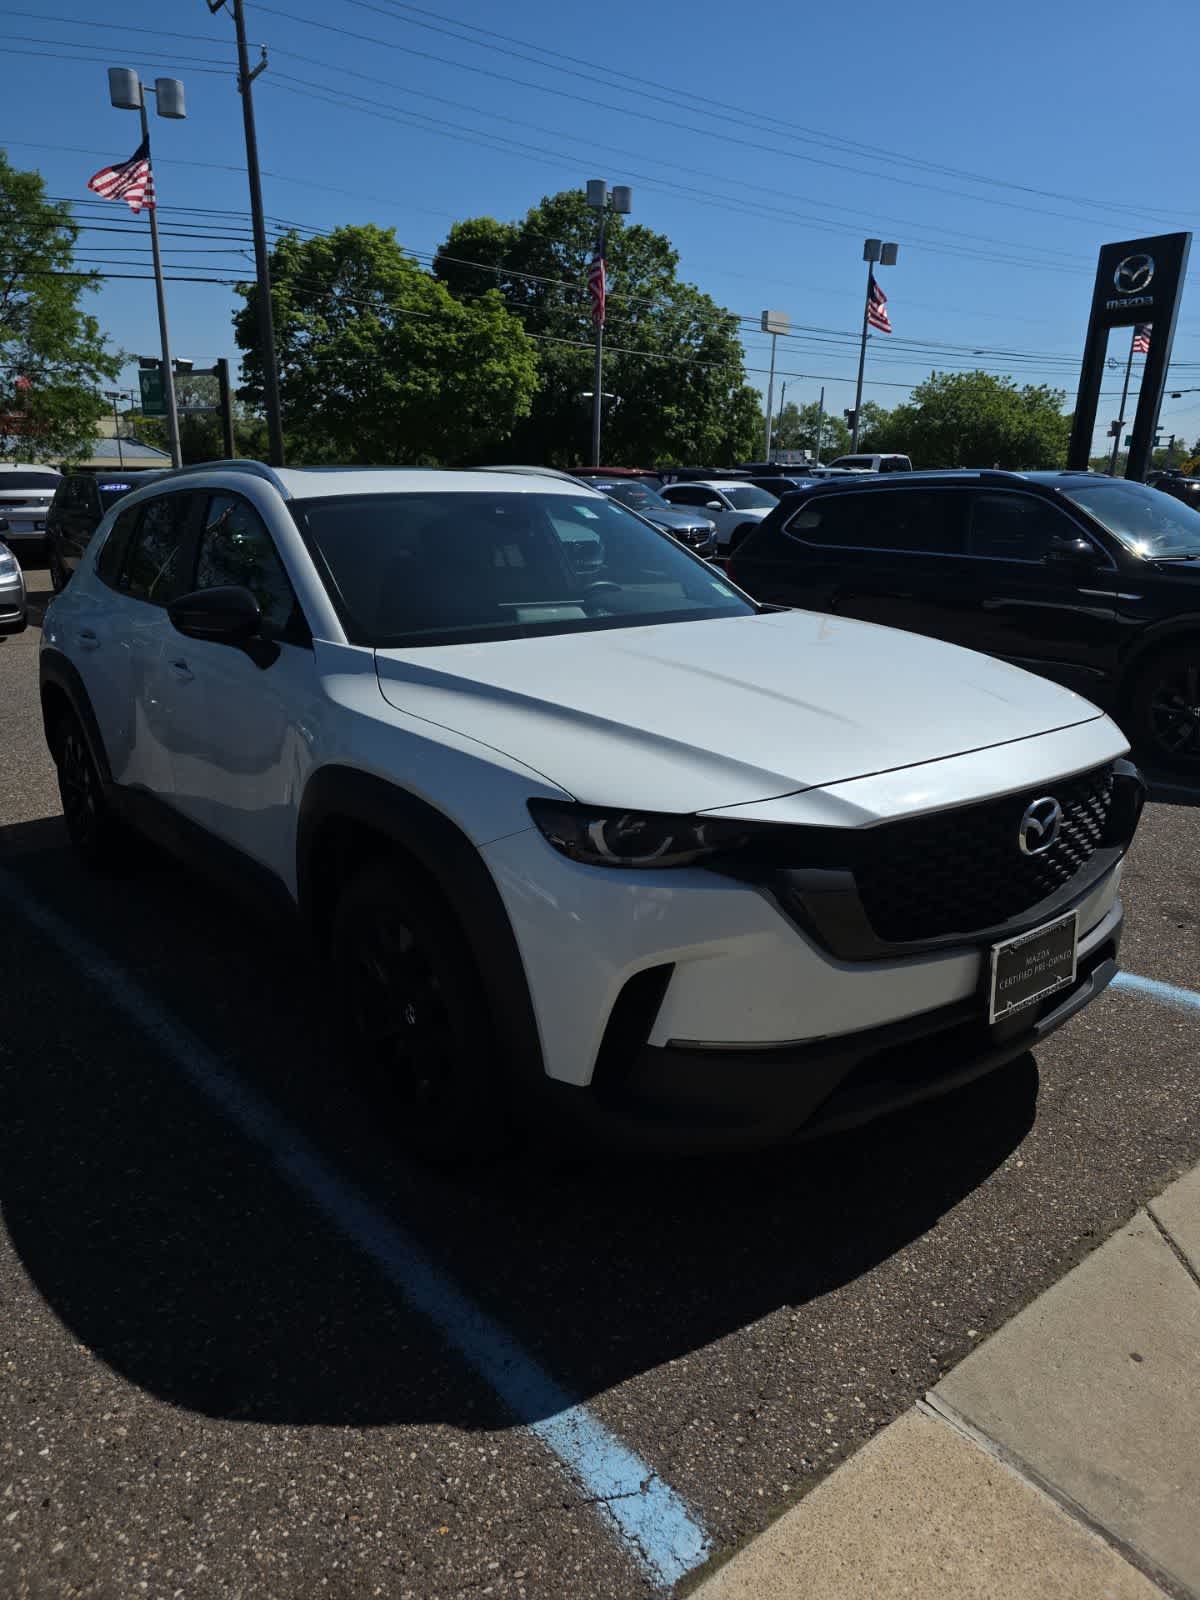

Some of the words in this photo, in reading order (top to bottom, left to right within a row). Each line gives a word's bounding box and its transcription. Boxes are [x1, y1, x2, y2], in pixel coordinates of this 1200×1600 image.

[999, 968, 1033, 991] CERTIFIED
[1034, 950, 1072, 974] PRE-OWNED
[1025, 949, 1050, 966] MAZDA
